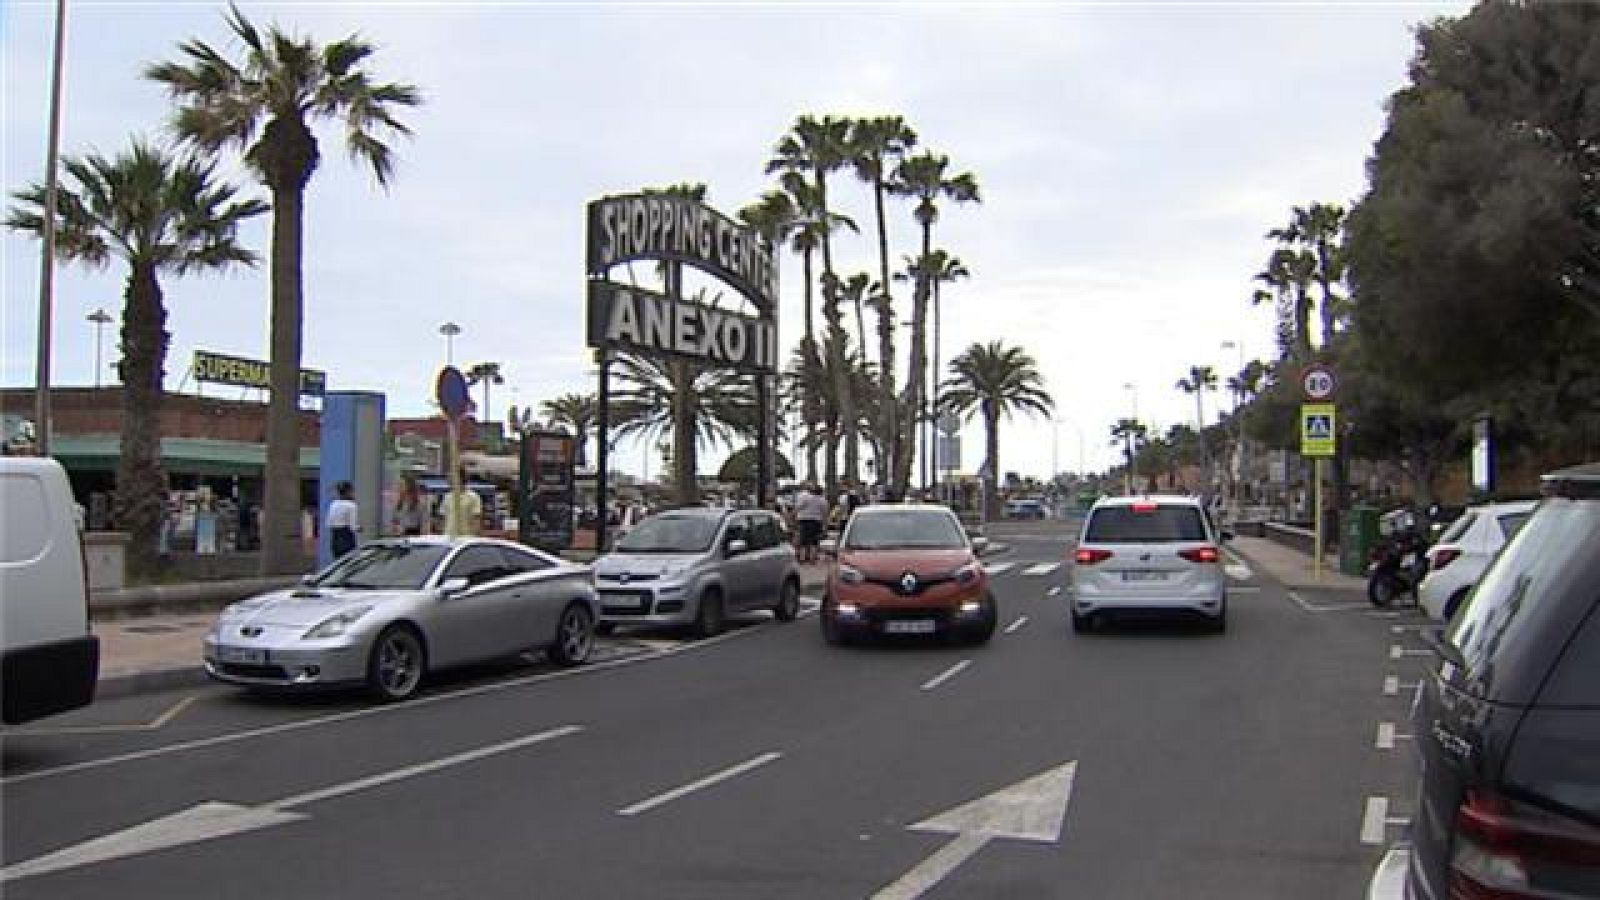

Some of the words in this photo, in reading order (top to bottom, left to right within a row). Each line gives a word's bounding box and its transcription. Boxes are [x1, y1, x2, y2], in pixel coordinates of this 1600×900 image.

[601, 199, 712, 264] SHOPPING
[605, 289, 746, 362] ANEXO
[755, 323, 776, 367] II
